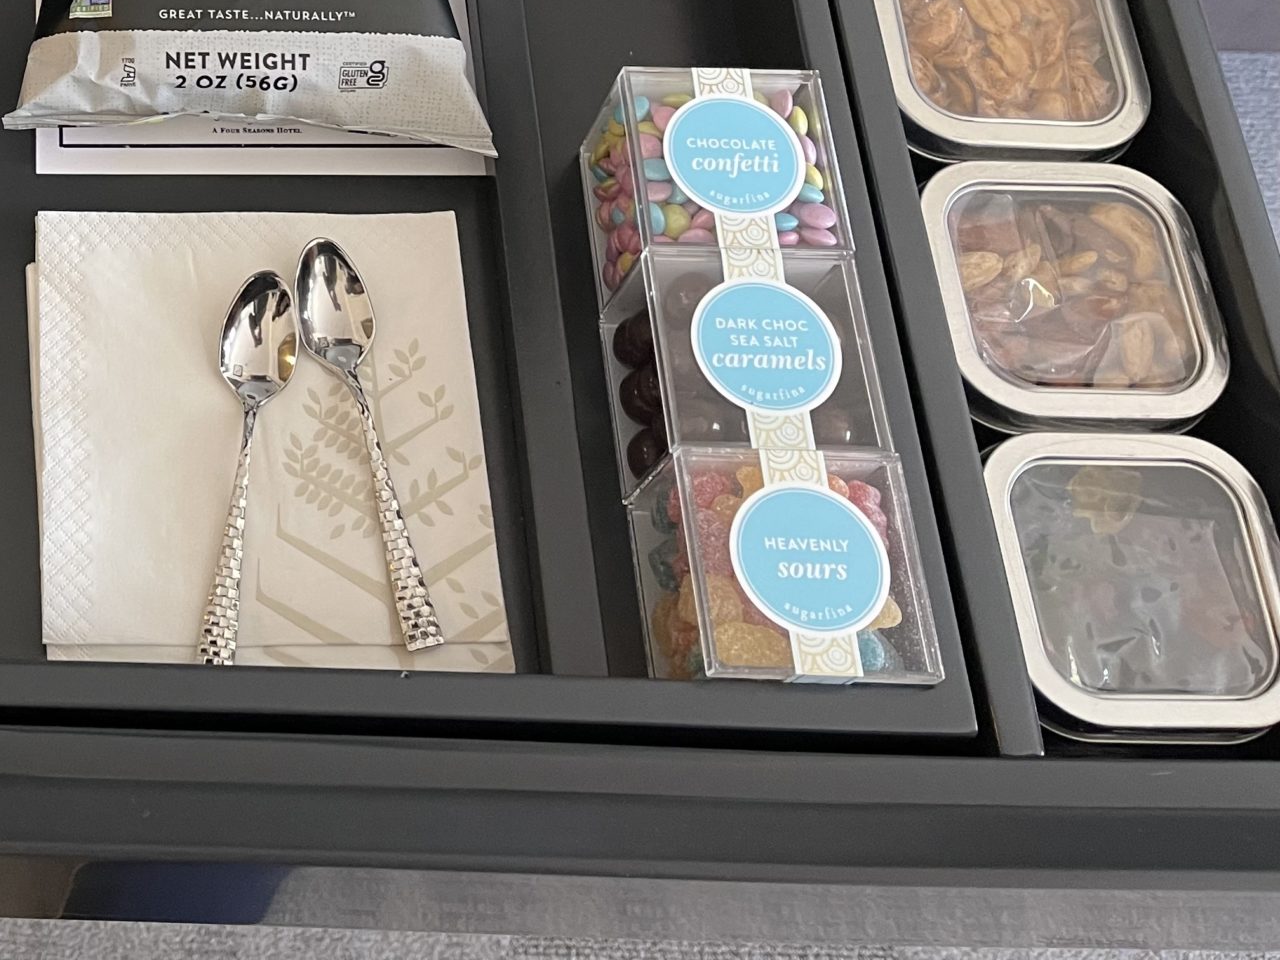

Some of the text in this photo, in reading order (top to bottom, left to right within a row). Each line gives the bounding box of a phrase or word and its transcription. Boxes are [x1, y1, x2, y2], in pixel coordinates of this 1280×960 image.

[159, 9, 203, 19] GREAT
[165, 52, 311, 71] NET WEIGHT
[342, 69, 369, 78] GLUTEN
[174, 73, 298, 92] 2 OZ (56G)
[341, 78, 357, 86] FREE
[687, 137, 777, 151] CHOCOLATE
[692, 153, 780, 179] confetti
[715, 318, 809, 332] DARK CHOC
[730, 334, 799, 348] SEA SALT
[712, 348, 827, 371] caramels
[764, 537, 849, 553] HEAVENLY
[777, 561, 848, 581] sours
